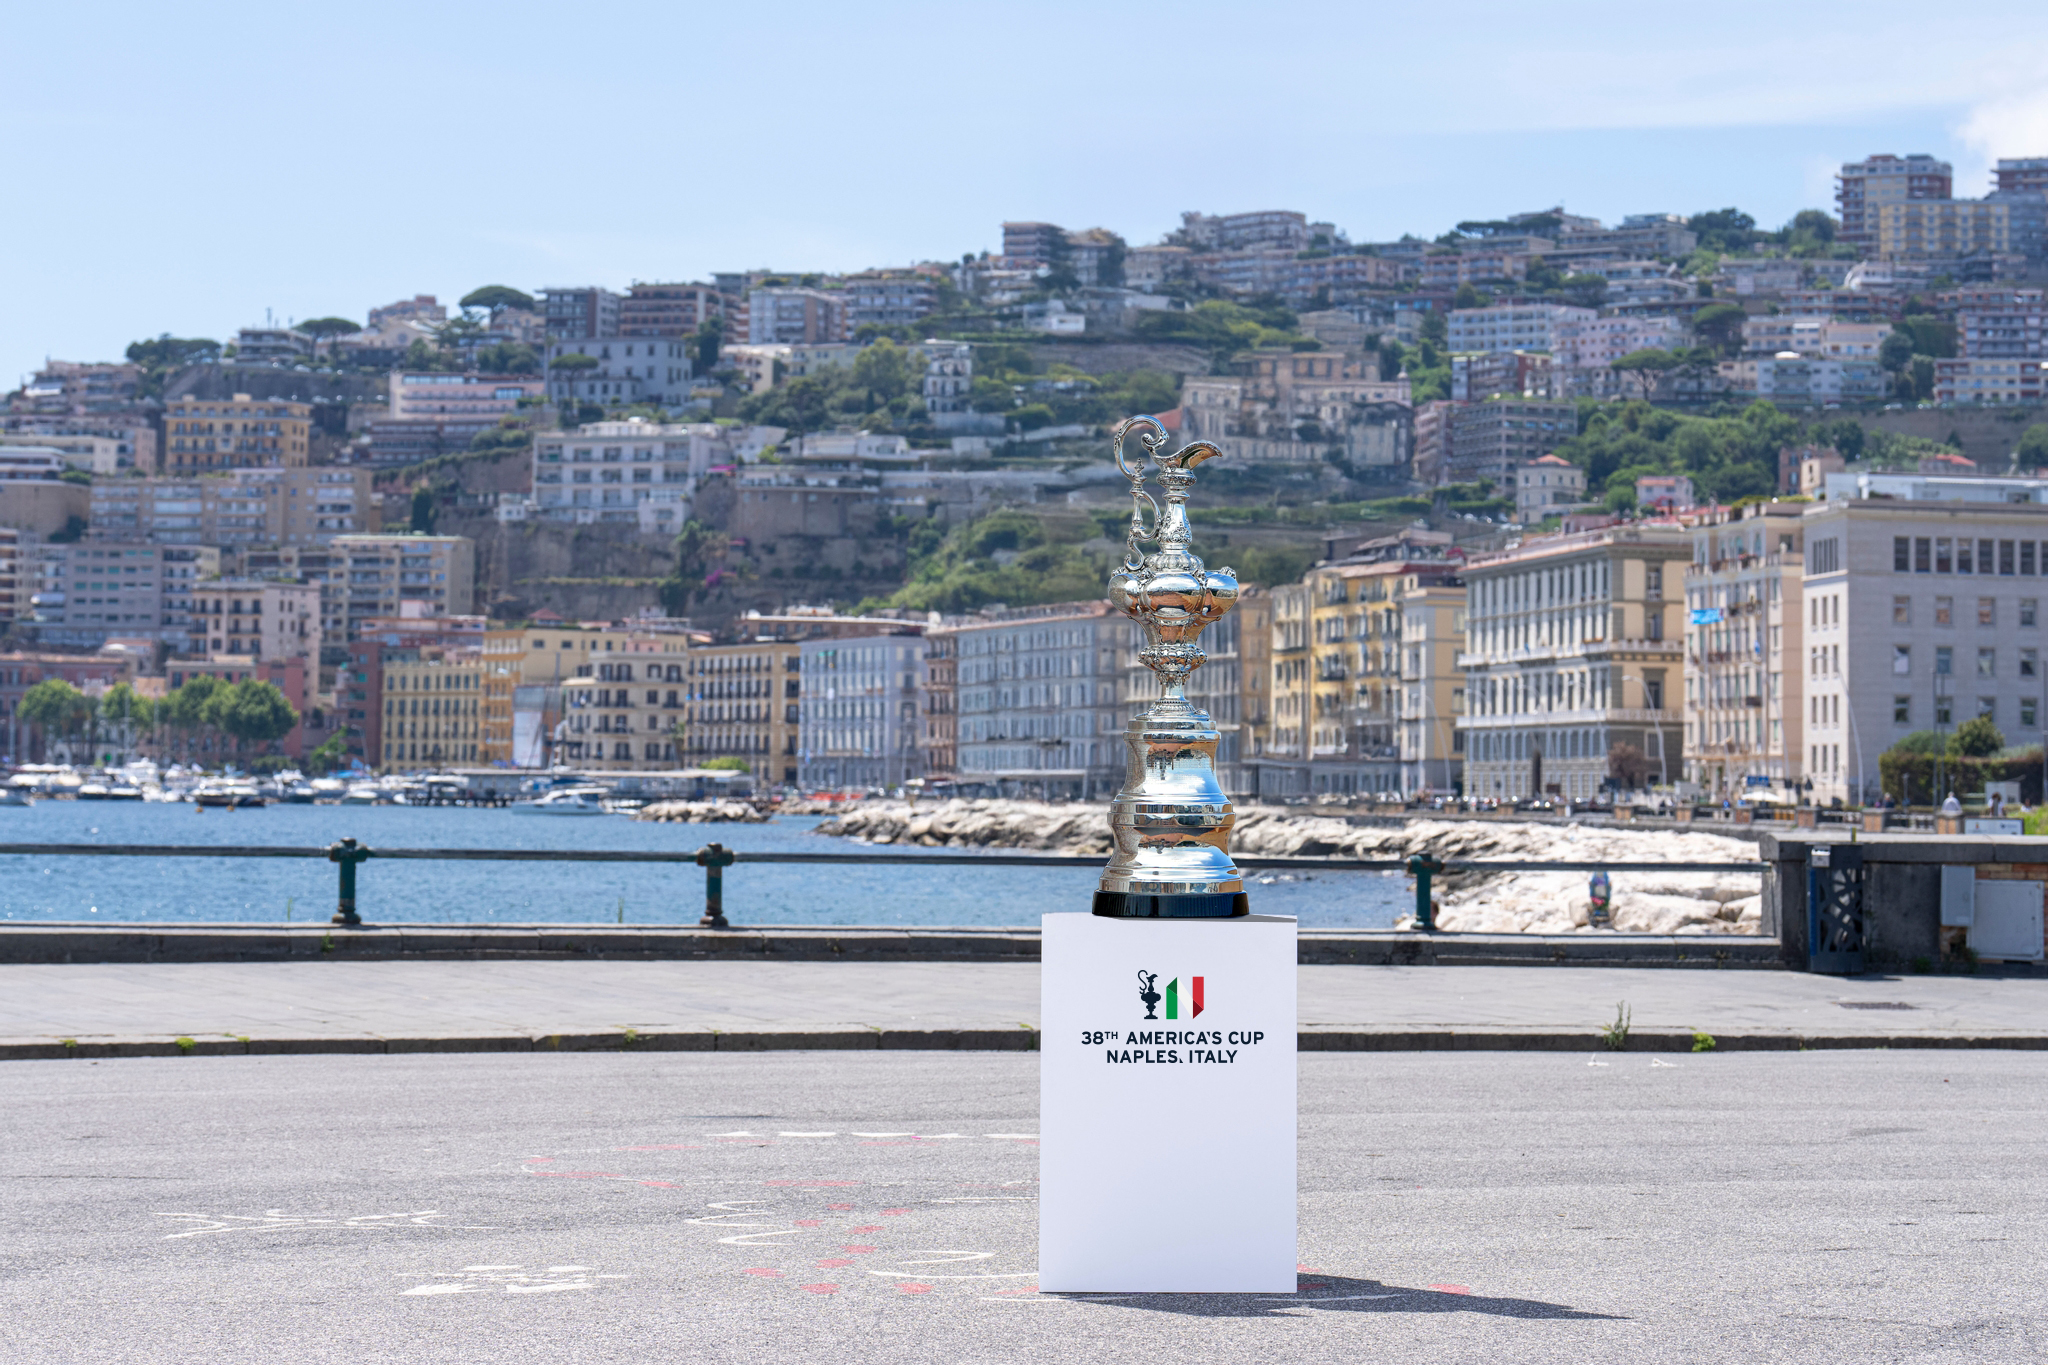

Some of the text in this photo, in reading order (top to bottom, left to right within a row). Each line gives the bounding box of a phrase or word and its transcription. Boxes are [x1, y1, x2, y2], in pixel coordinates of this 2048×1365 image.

[1081, 1030, 1265, 1046] 38TH AMERICA'S CUP
[1189, 1049, 1238, 1064] ITALY
